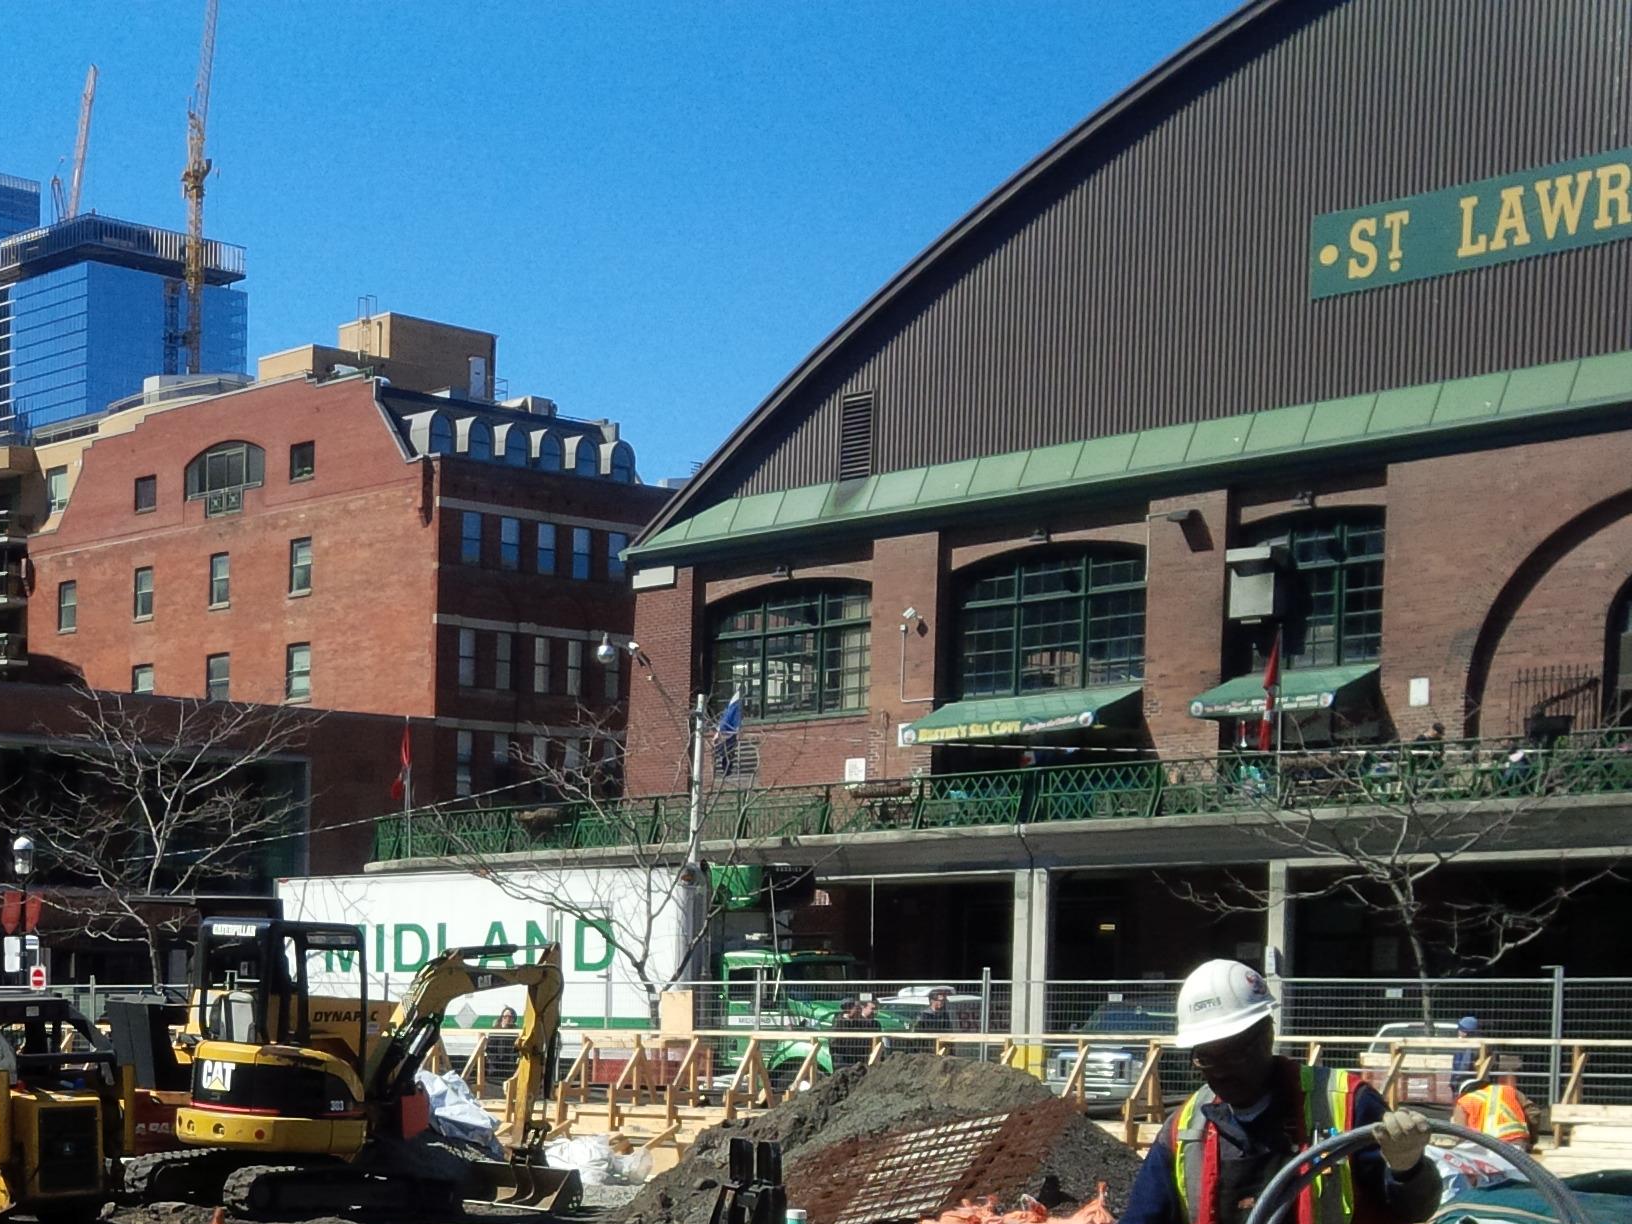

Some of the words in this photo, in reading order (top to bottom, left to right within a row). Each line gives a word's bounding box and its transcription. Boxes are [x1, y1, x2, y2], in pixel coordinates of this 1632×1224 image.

[1456, 162, 1632, 259] LAWR
[477, 975, 493, 988] CAT
[312, 1010, 379, 1022] DYNAPC
[202, 1059, 236, 1092] CAT
